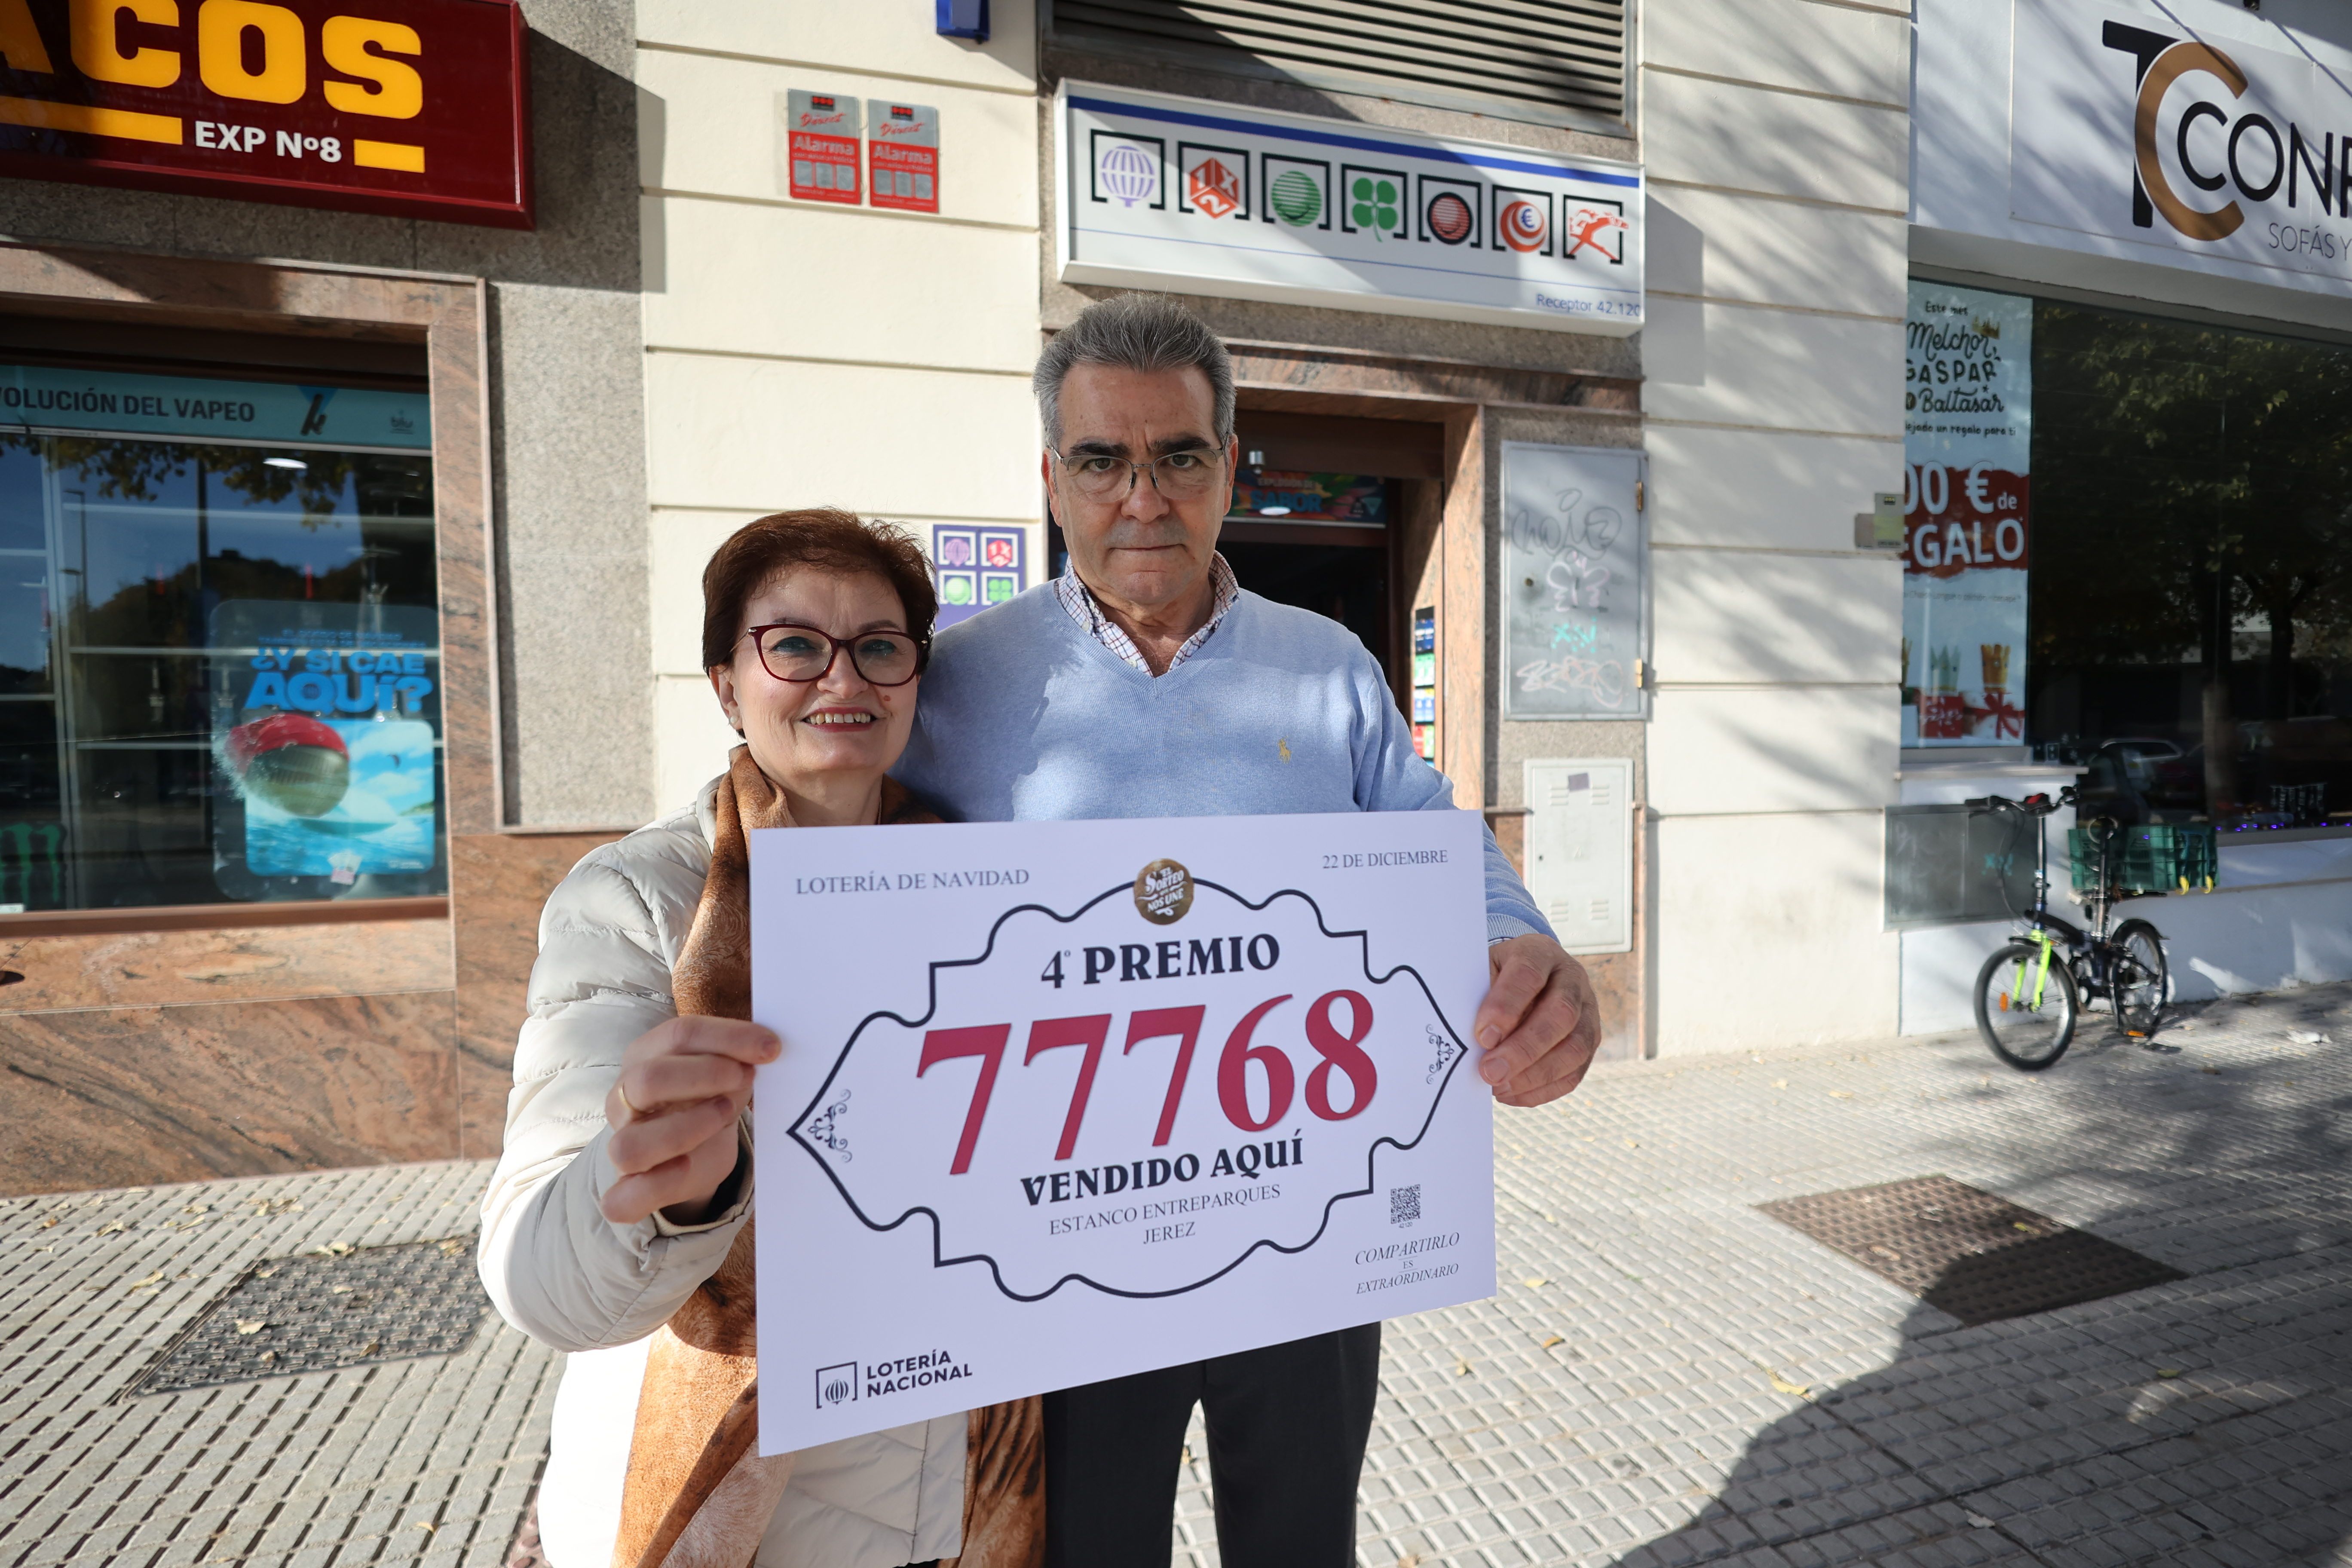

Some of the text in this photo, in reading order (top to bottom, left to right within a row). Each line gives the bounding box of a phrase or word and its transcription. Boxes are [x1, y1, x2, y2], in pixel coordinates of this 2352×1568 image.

[195, 120, 267, 153] EXP
[793, 135, 854, 156] Alarma
[873, 145, 933, 165] Alarma
[2269, 223, 2352, 261] SOFÁS Y
[1536, 293, 1640, 317] Receptor 42.120
[1925, 300, 1947, 313] Este
[0, 387, 256, 423] OLUCIÓN DEL VAPEO
[1951, 424, 1981, 438] regalo
[1984, 427, 2006, 438] para
[1250, 490, 1323, 513] SABOR
[1997, 491, 2018, 510] de
[250, 646, 426, 675] ¿Y SI CAE
[243, 671, 433, 715] AQUÍ?
[1322, 849, 1449, 869] 22 DE DICIEMBRE
[796, 868, 1029, 895] LOTERÍA DE NAVIDAD
[1147, 887, 1184, 913] NOS UNE
[1083, 933, 1280, 985] PREMIO
[915, 989, 1378, 1176] 77768
[1020, 1129, 1303, 1206] VENDIDO AQUÍ
[1049, 1184, 1281, 1236] ESTANCO ENTREPARQUES
[1142, 1221, 1196, 1245] JEREZ
[1355, 1231, 1460, 1265] COMPARTIRLO
[1356, 1263, 1459, 1295] EXTRAORDINARIO
[1403, 1260, 1414, 1269] ES
[867, 1348, 952, 1380] LOTERÍA
[867, 1363, 973, 1398] NACIONAL
